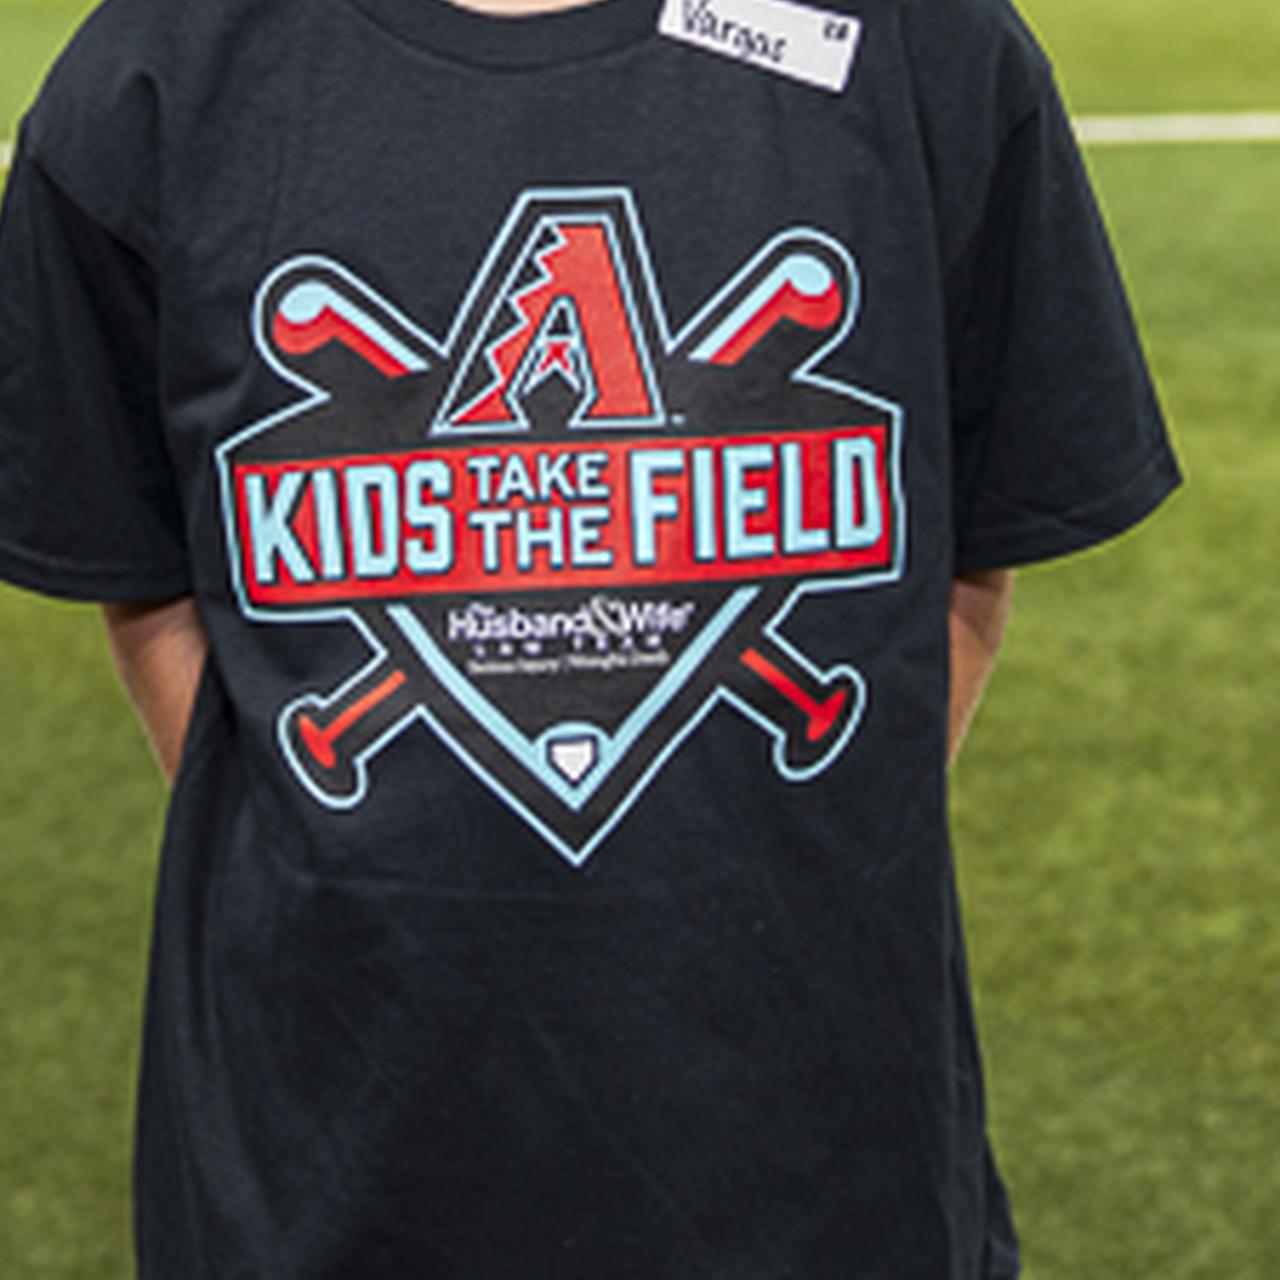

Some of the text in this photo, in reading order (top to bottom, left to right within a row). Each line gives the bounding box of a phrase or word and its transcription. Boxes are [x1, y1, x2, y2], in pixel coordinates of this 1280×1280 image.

[245, 434, 884, 585] KIDS TAKE FIELD
[468, 506, 614, 572] THE
[447, 606, 592, 640] Husband
